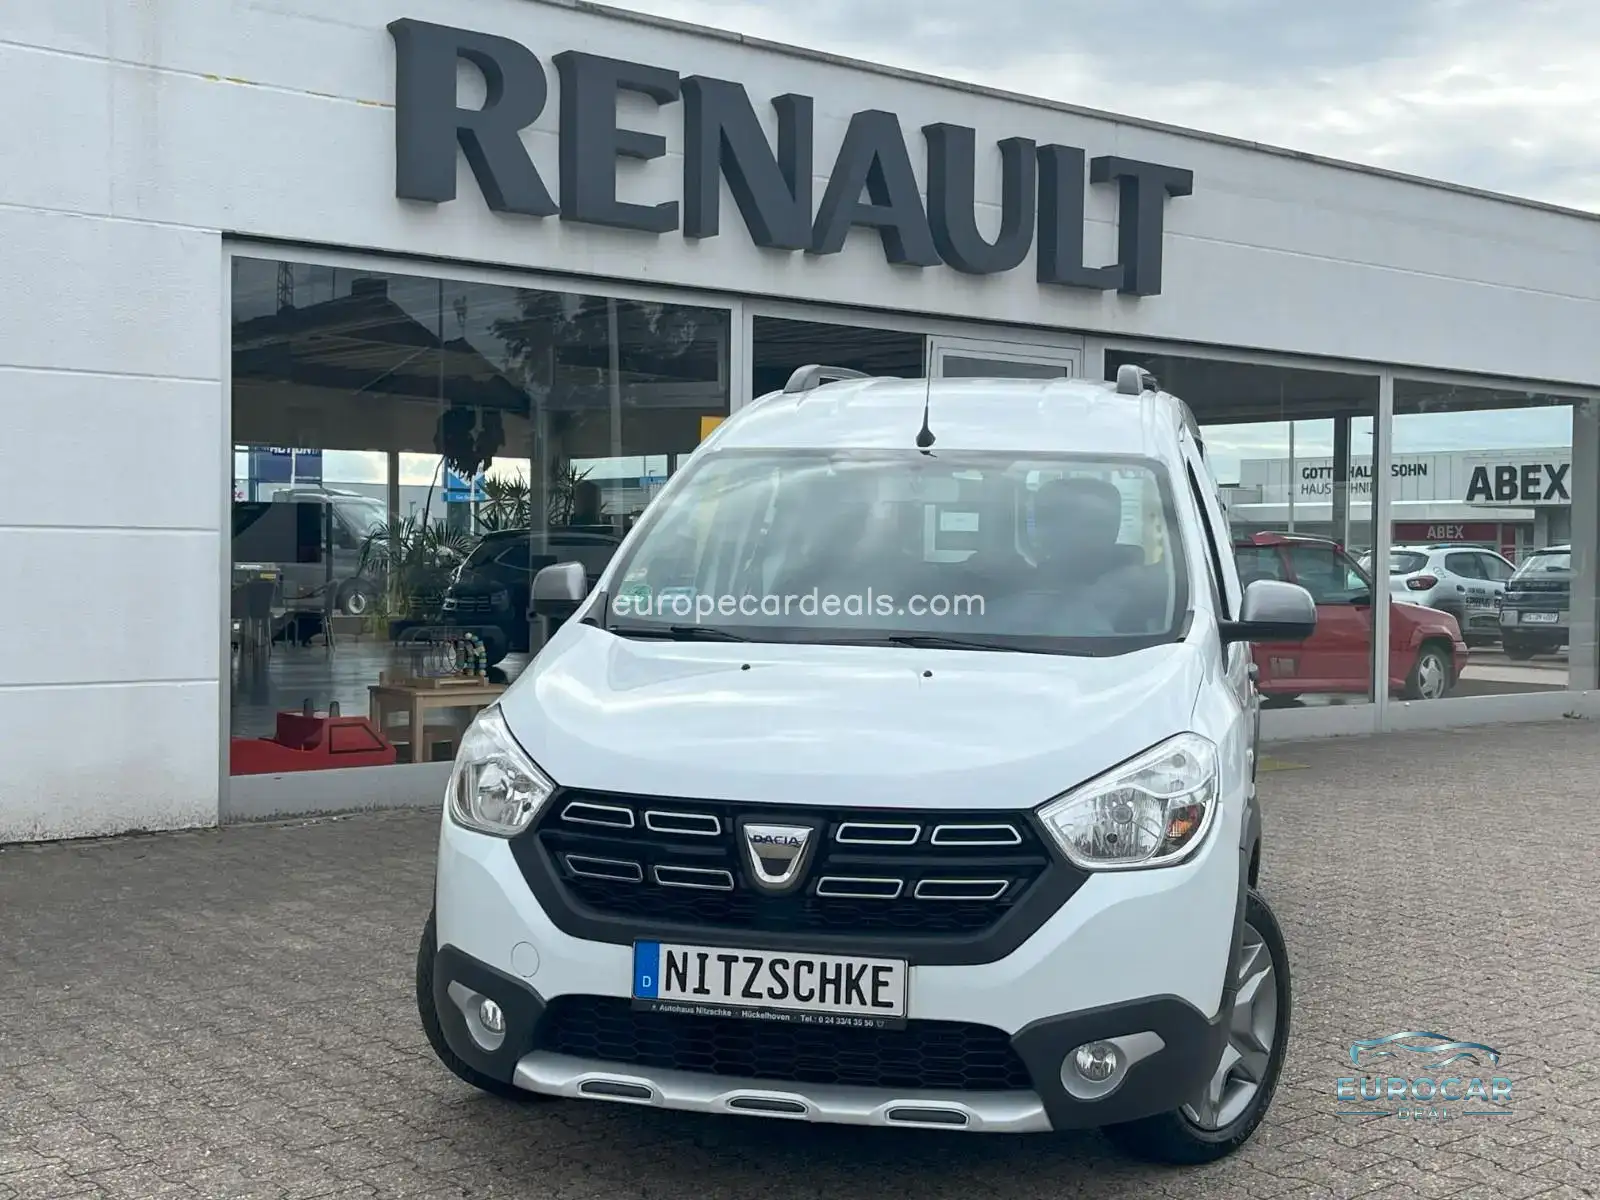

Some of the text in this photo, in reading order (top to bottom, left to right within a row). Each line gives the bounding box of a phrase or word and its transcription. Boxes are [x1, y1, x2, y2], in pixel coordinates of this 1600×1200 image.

[387, 18, 1193, 296] RENAULT
[1391, 464, 1427, 477] SOHN
[1466, 464, 1570, 501] ABEX
[1426, 525, 1464, 539] ABEX
[752, 834, 799, 845] DACIA
[643, 950, 894, 1008] D NITZSCHKE
[659, 1004, 694, 1014] Autohaus
[742, 1010, 790, 1021] Hückelhoven
